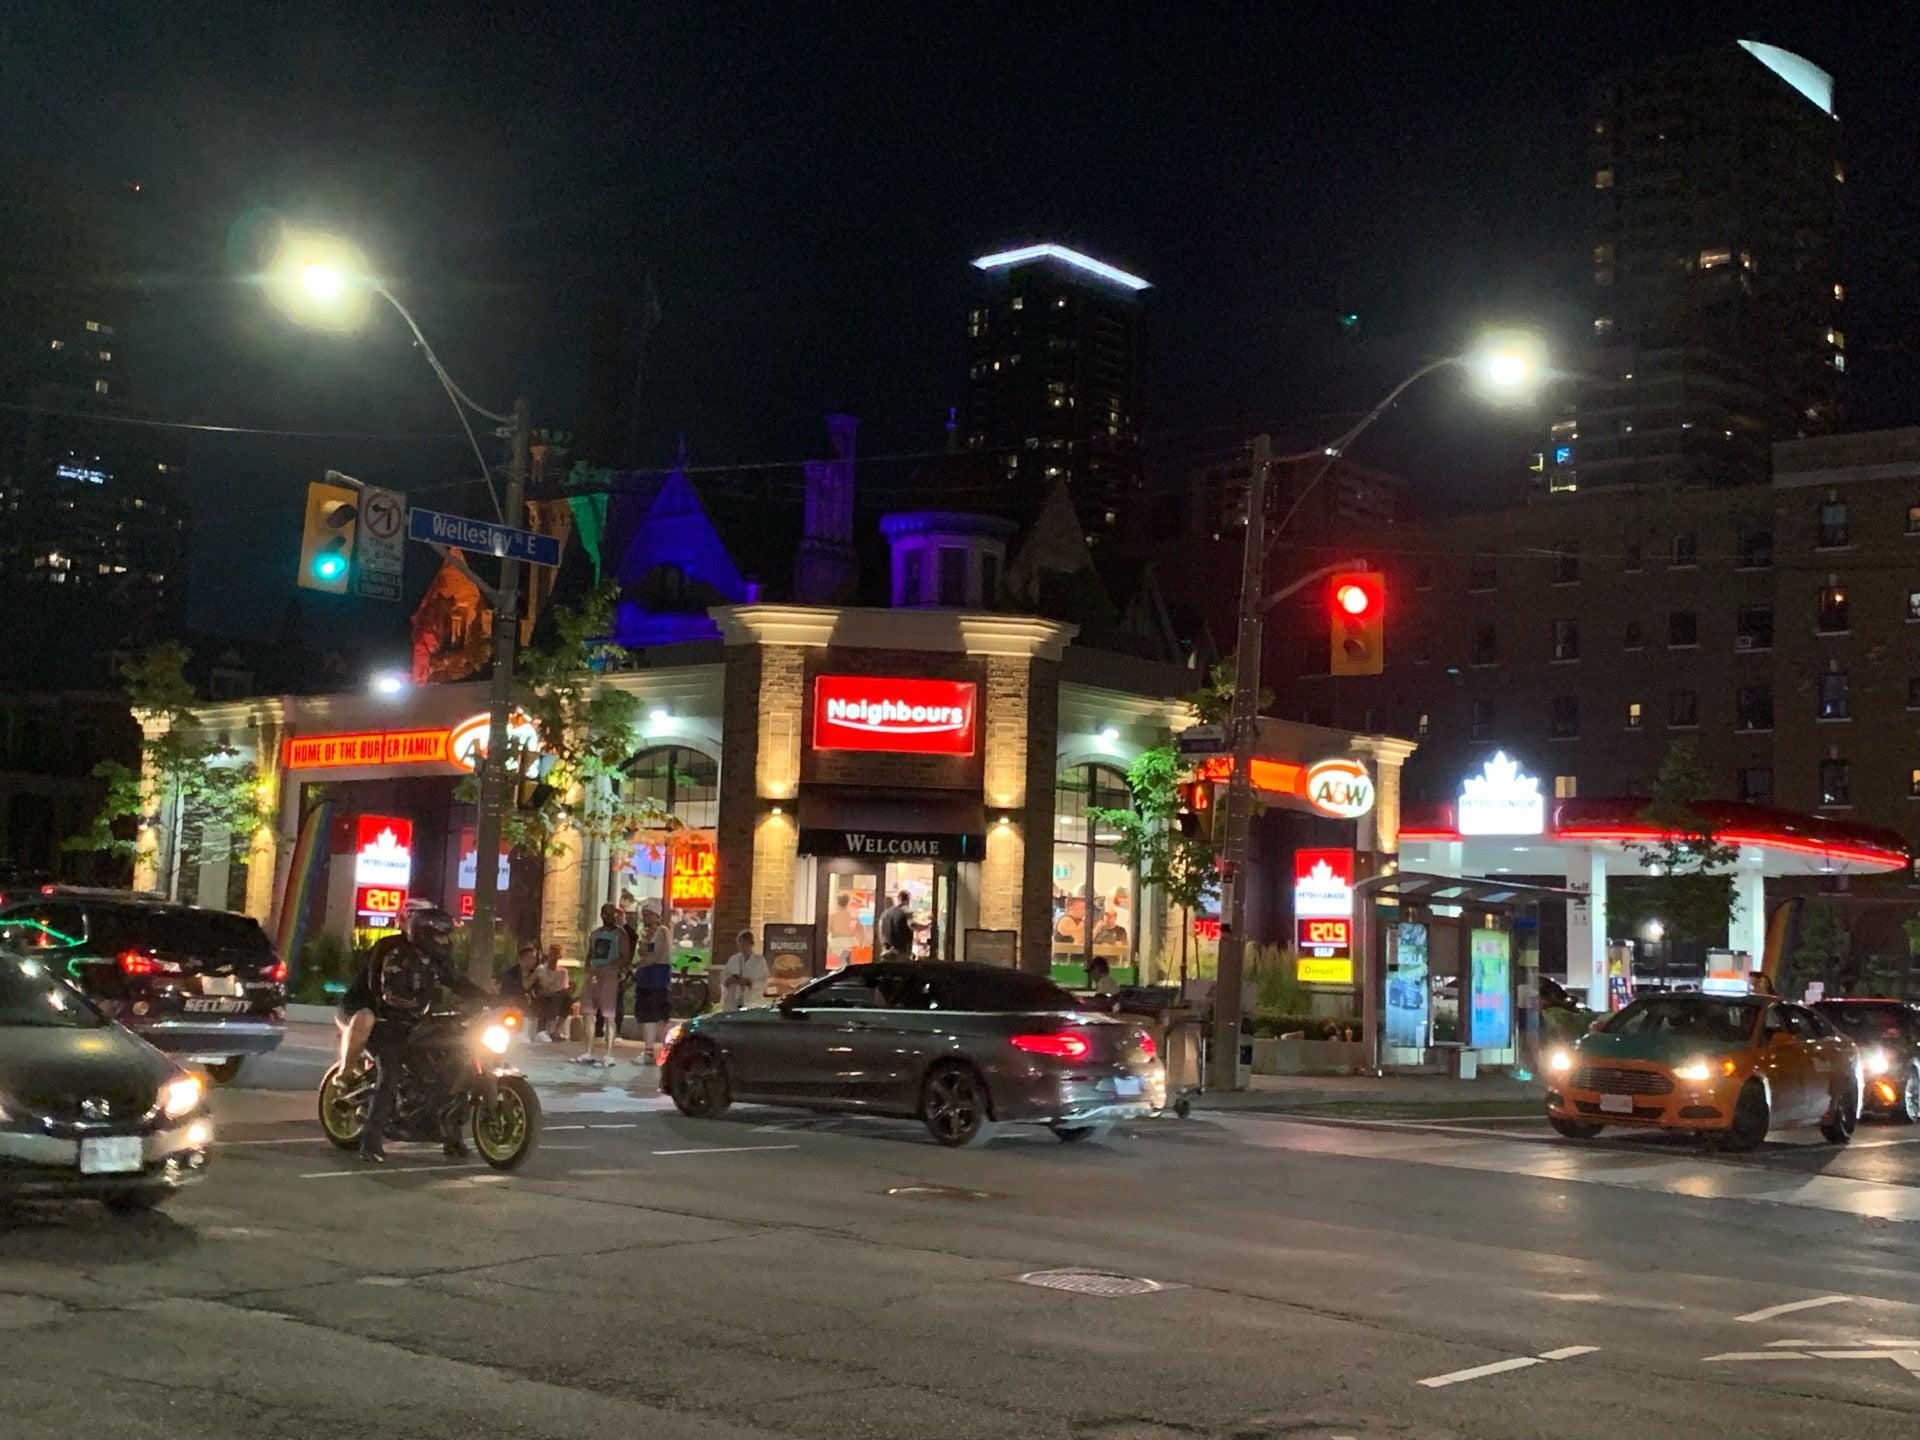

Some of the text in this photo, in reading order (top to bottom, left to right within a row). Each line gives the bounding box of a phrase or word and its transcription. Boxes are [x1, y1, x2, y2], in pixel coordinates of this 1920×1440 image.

[433, 514, 512, 553] Wellesley
[527, 535, 537, 555] E
[827, 698, 964, 726] Neighbours
[294, 743, 322, 762] HOME
[325, 742, 337, 761] OF
[339, 741, 356, 759] THE
[402, 736, 440, 755] FAMILY
[770, 941, 808, 951] BURGER
